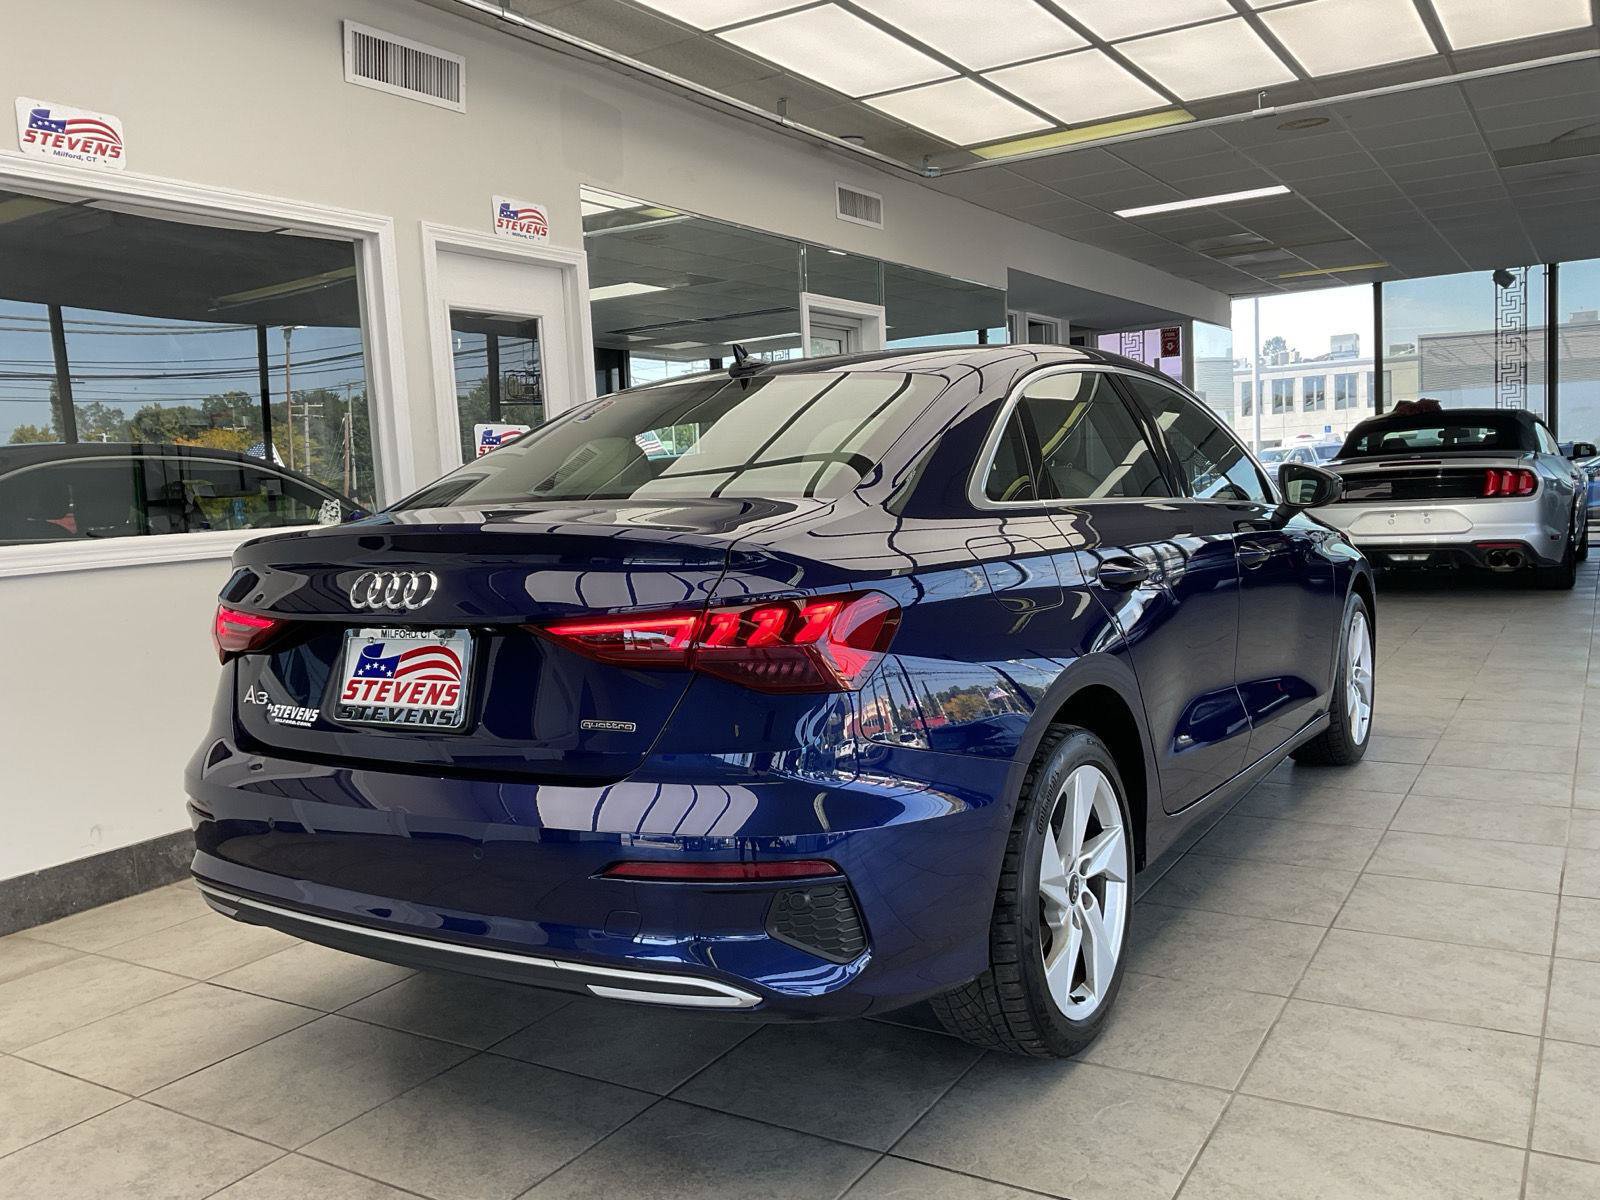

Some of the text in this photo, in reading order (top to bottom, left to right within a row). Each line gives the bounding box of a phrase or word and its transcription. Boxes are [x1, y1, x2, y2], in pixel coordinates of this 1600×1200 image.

[23, 129, 123, 159] STEVENS
[53, 149, 98, 163] Milford, CT
[497, 218, 548, 236] STEVENS
[243, 684, 269, 705] A3
[342, 679, 461, 706] STEVENS
[271, 704, 320, 722] STEVENS
[340, 704, 456, 726] STEVENS
[583, 721, 633, 731] quattro
